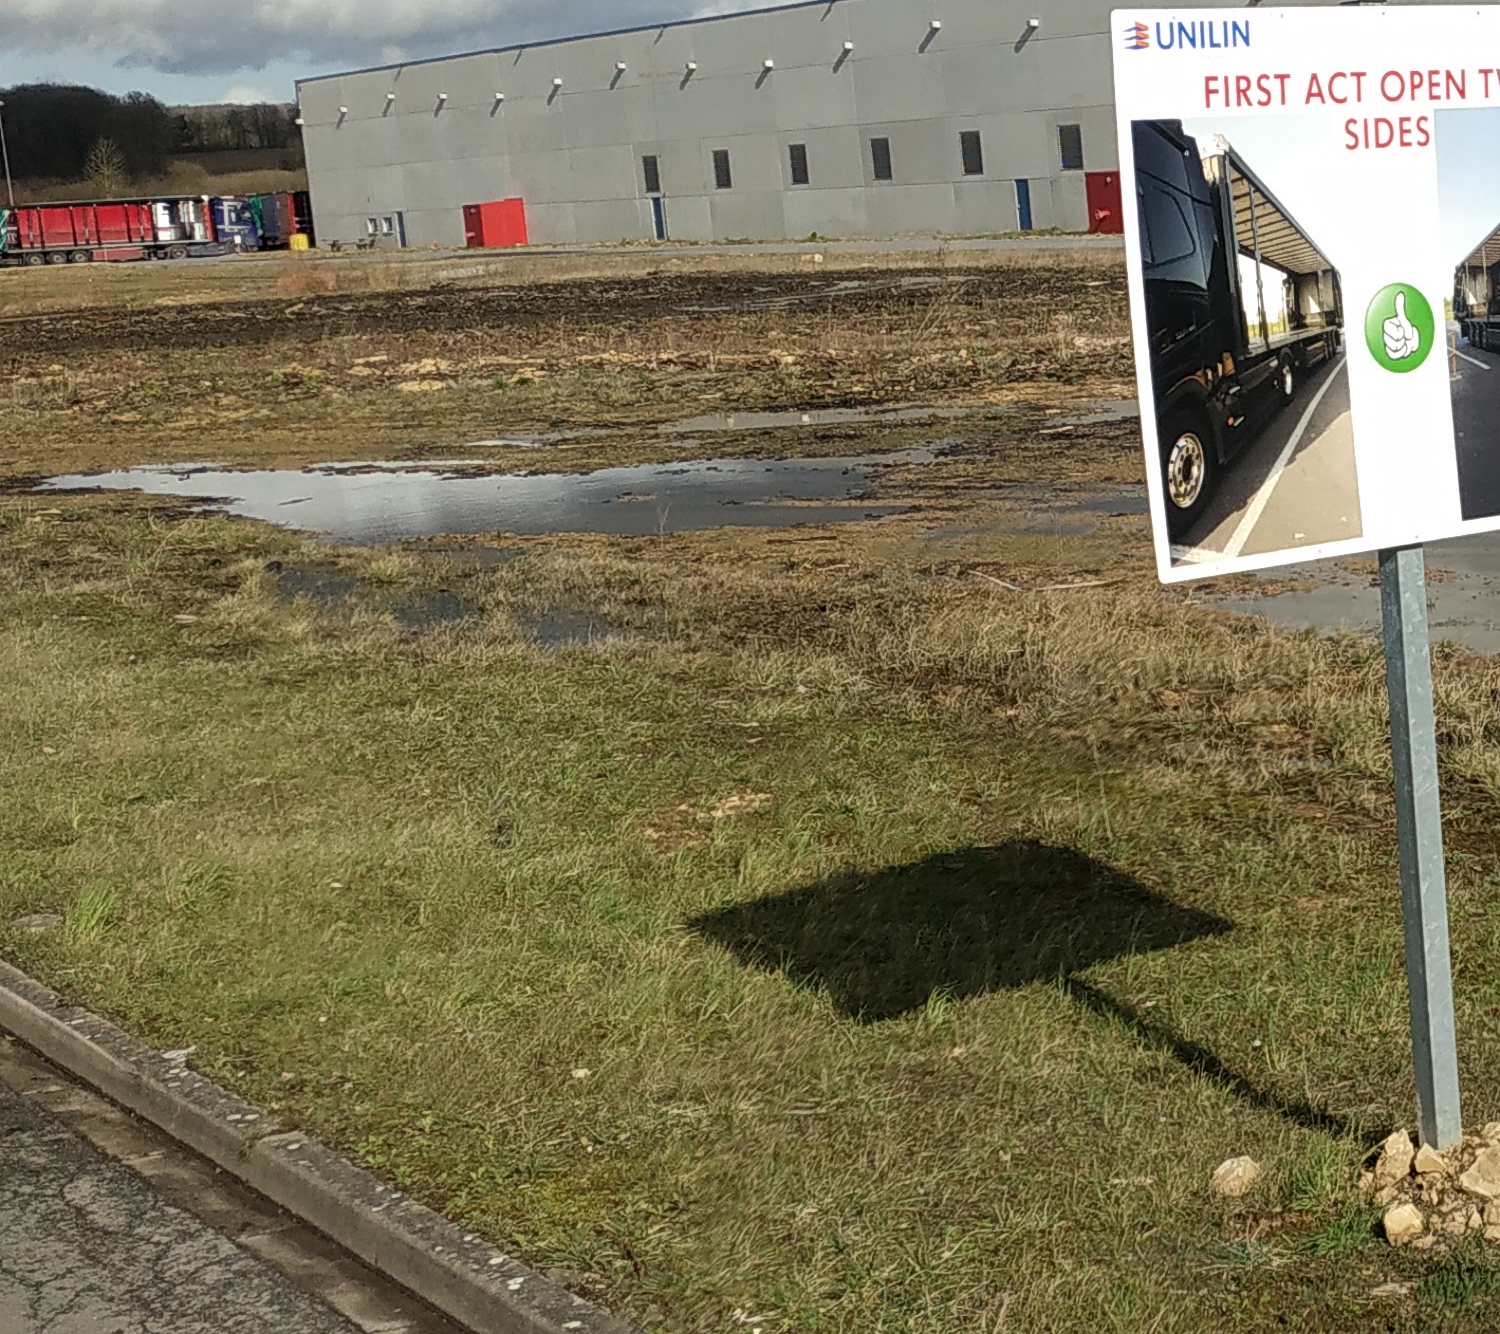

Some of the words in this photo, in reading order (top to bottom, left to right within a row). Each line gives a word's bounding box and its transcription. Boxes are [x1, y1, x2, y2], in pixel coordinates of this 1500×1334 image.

[1156, 21, 1250, 50] UNILIN
[1204, 73, 1291, 108] FIRST
[1305, 71, 1366, 104] ACT
[1380, 69, 1466, 102] OPEN
[1344, 116, 1430, 150] SIDES
